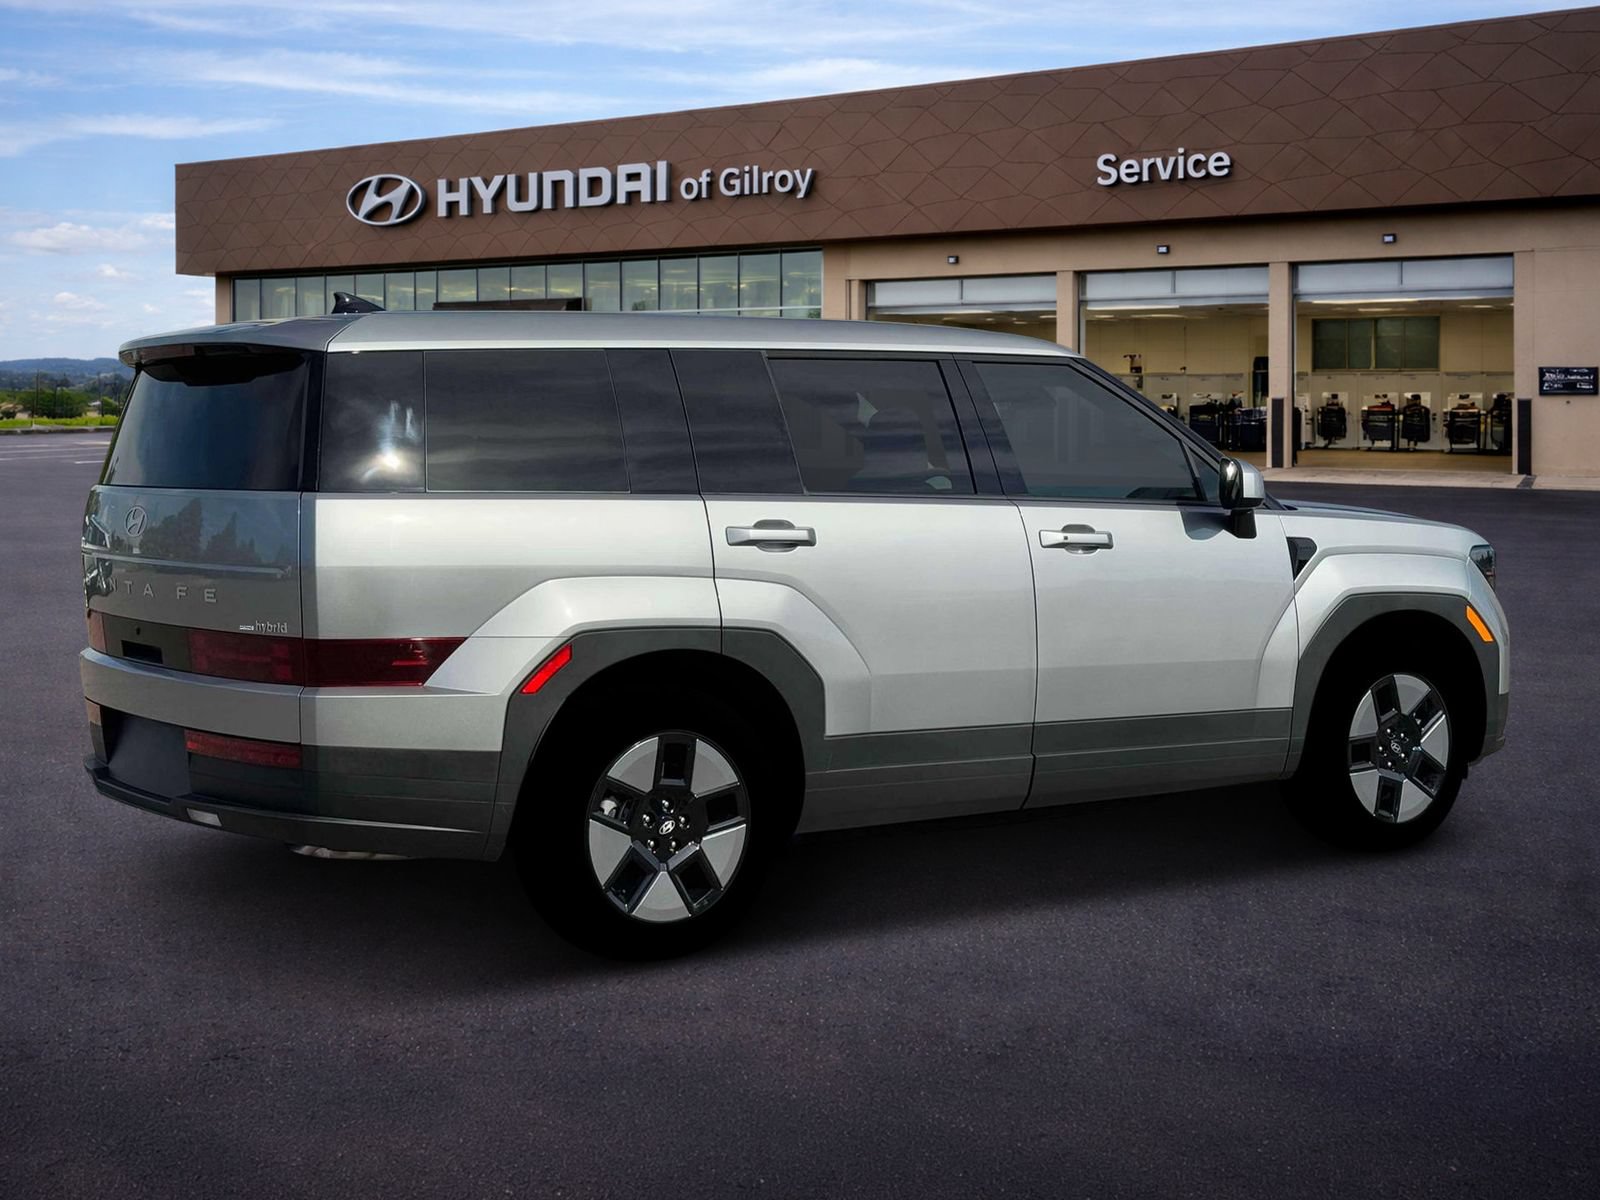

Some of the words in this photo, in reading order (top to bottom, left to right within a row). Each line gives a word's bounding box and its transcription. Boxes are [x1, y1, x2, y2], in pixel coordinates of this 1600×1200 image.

[1096, 147, 1231, 186] Service
[437, 160, 669, 217] HYUNDAI
[680, 168, 711, 200] of
[719, 165, 813, 199] Gilroy
[176, 586, 217, 603] FE
